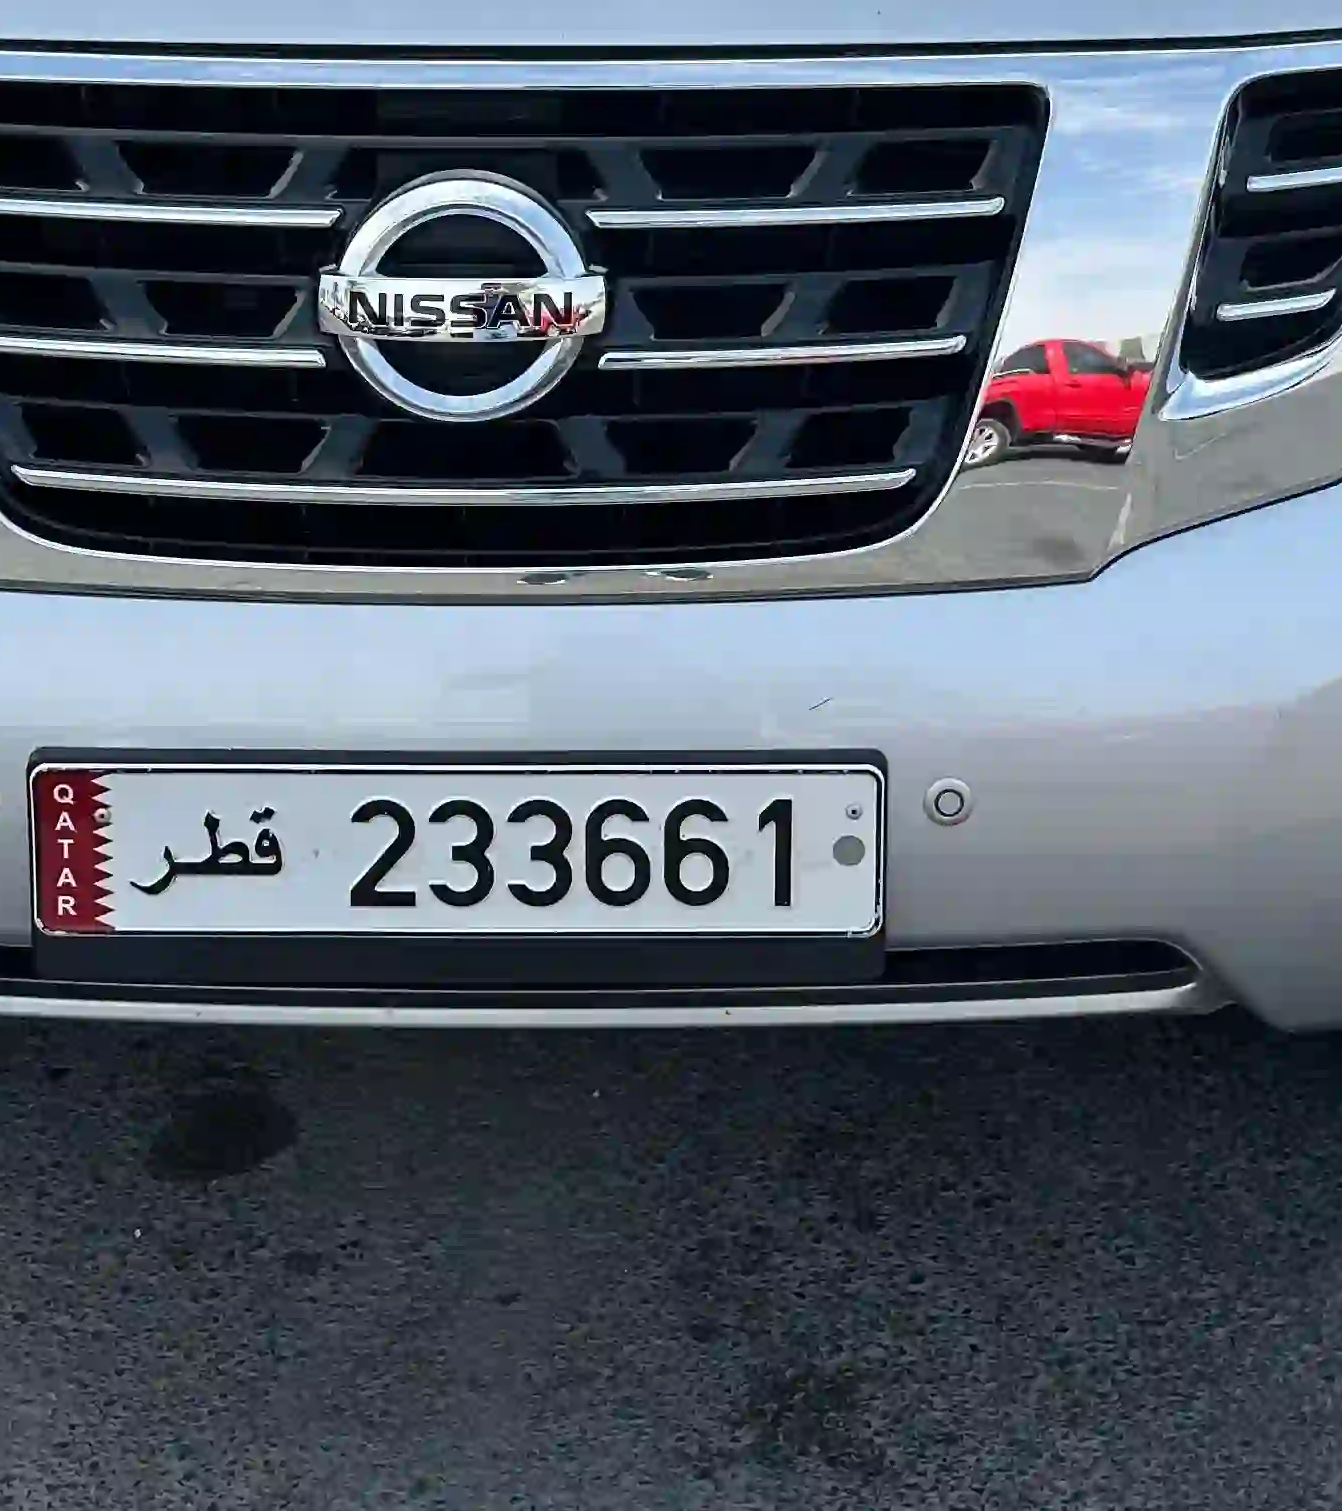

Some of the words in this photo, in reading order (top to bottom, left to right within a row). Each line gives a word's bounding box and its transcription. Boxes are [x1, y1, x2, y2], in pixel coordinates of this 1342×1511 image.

[348, 290, 574, 329] NISSAN
[53, 783, 78, 917] QATAR
[129, 805, 284, 896] قطر
[349, 797, 794, 908] 233661
